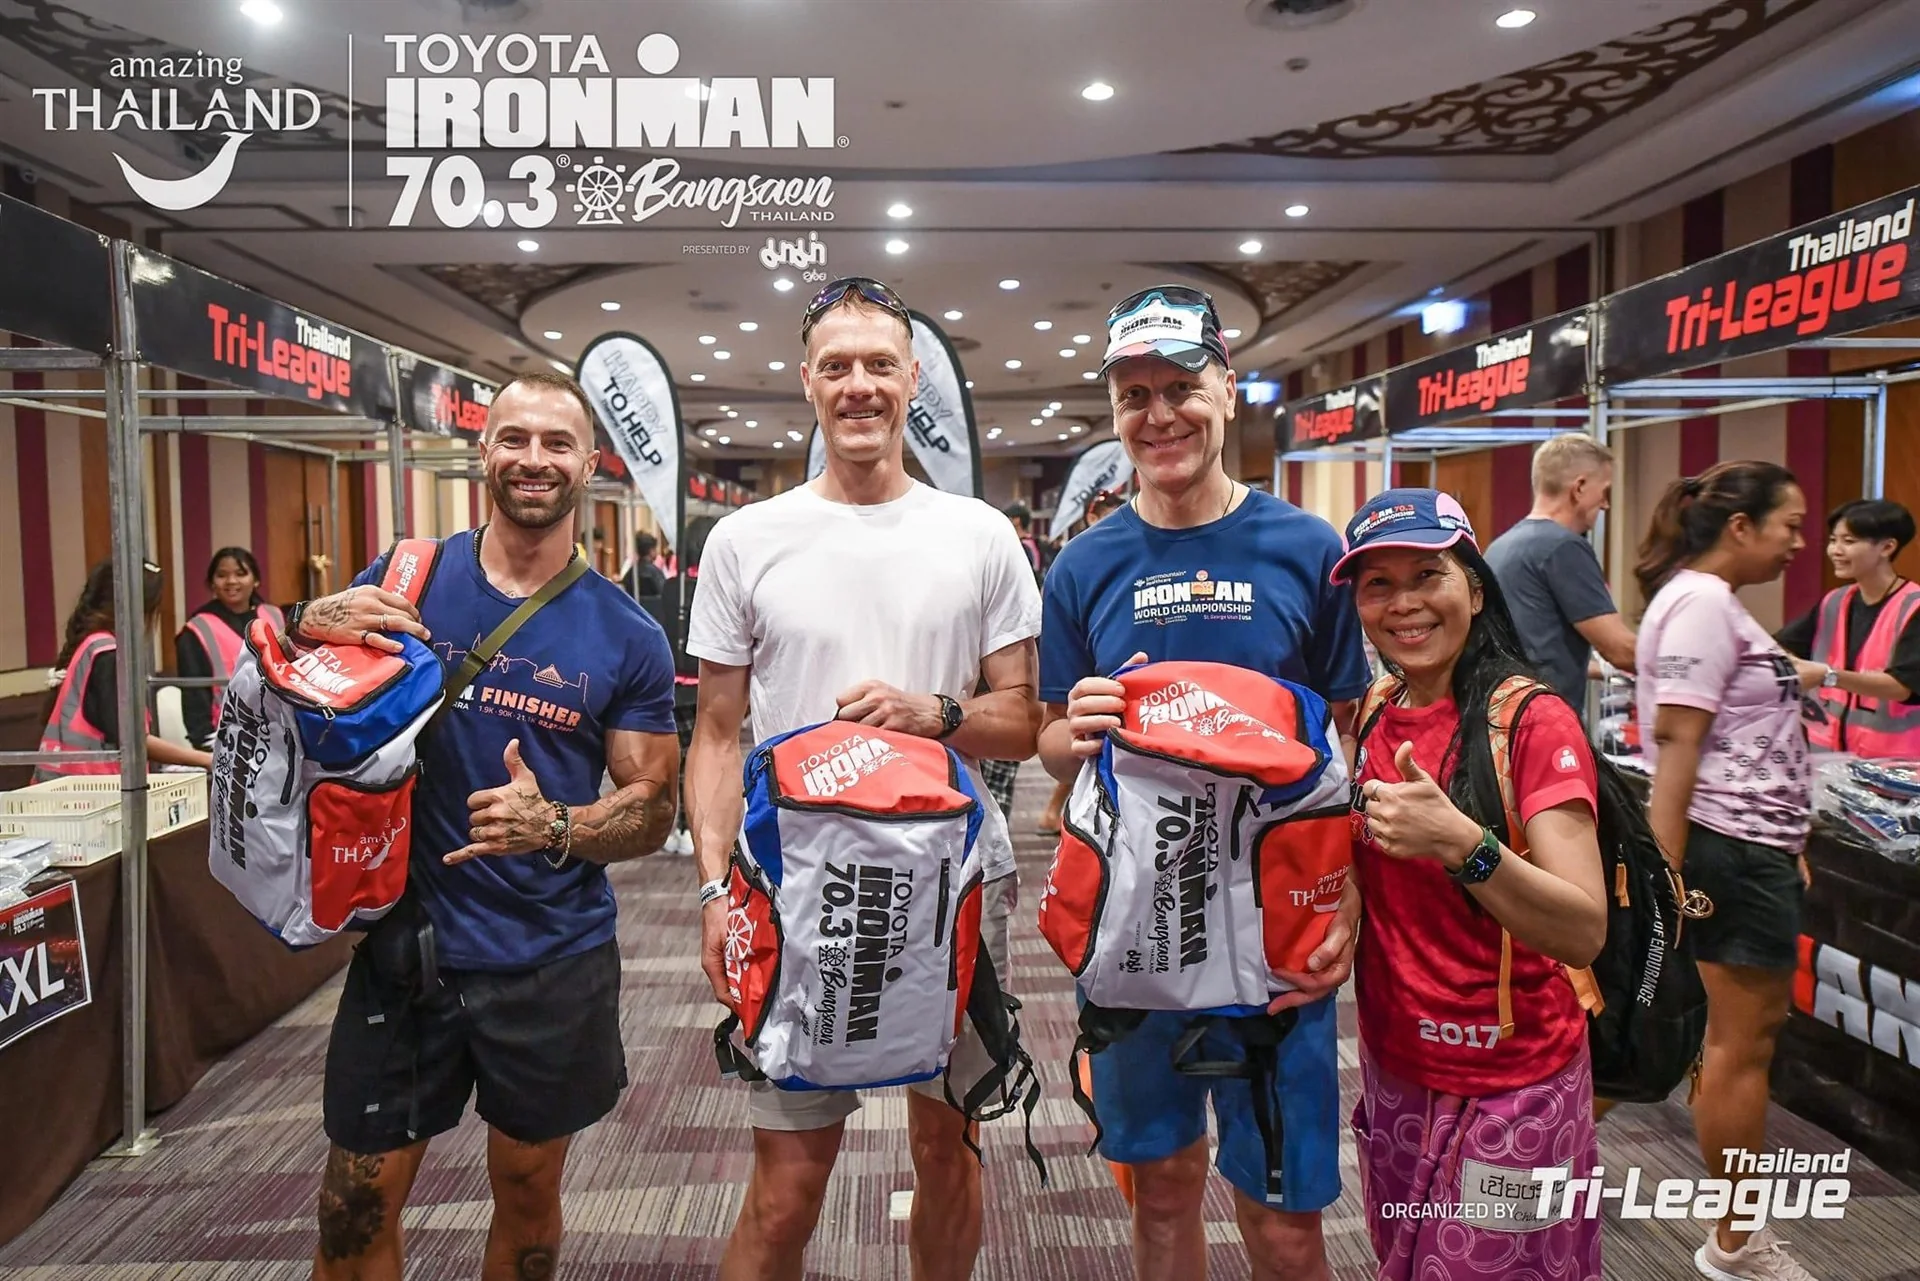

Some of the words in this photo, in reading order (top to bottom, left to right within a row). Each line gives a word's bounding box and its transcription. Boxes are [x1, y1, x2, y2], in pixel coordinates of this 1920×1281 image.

[1788, 198, 1916, 273] Thailand
[1665, 242, 1909, 356] Tri-League
[207, 303, 351, 401] Tri-League
[295, 315, 351, 361] Thailand
[1476, 329, 1532, 369] Thailand
[602, 350, 668, 439] HAPPY
[603, 376, 628, 412] TO
[621, 411, 663, 467] HELP
[1417, 356, 1531, 417] Tri-League
[1133, 606, 1171, 621] WORLD
[1171, 602, 1253, 615] CHAMPIONSHIP
[480, 686, 582, 727] FINISHER
[498, 709, 514, 719] 90K
[1139, 680, 1201, 707] TOYOTA
[228, 695, 261, 871] IRONMAN
[796, 734, 867, 774] TOYOTA
[818, 861, 857, 939] 70.3
[888, 868, 914, 960] TOYOTA
[1147, 891, 1176, 974] Bangsaen
[1653, 920, 1665, 938] OF
[845, 864, 894, 1044] IRONMAN
[1636, 937, 1665, 1007] ENDURANCE
[813, 967, 848, 1046] Bangsaen
[1418, 1018, 1501, 1050] 2017
